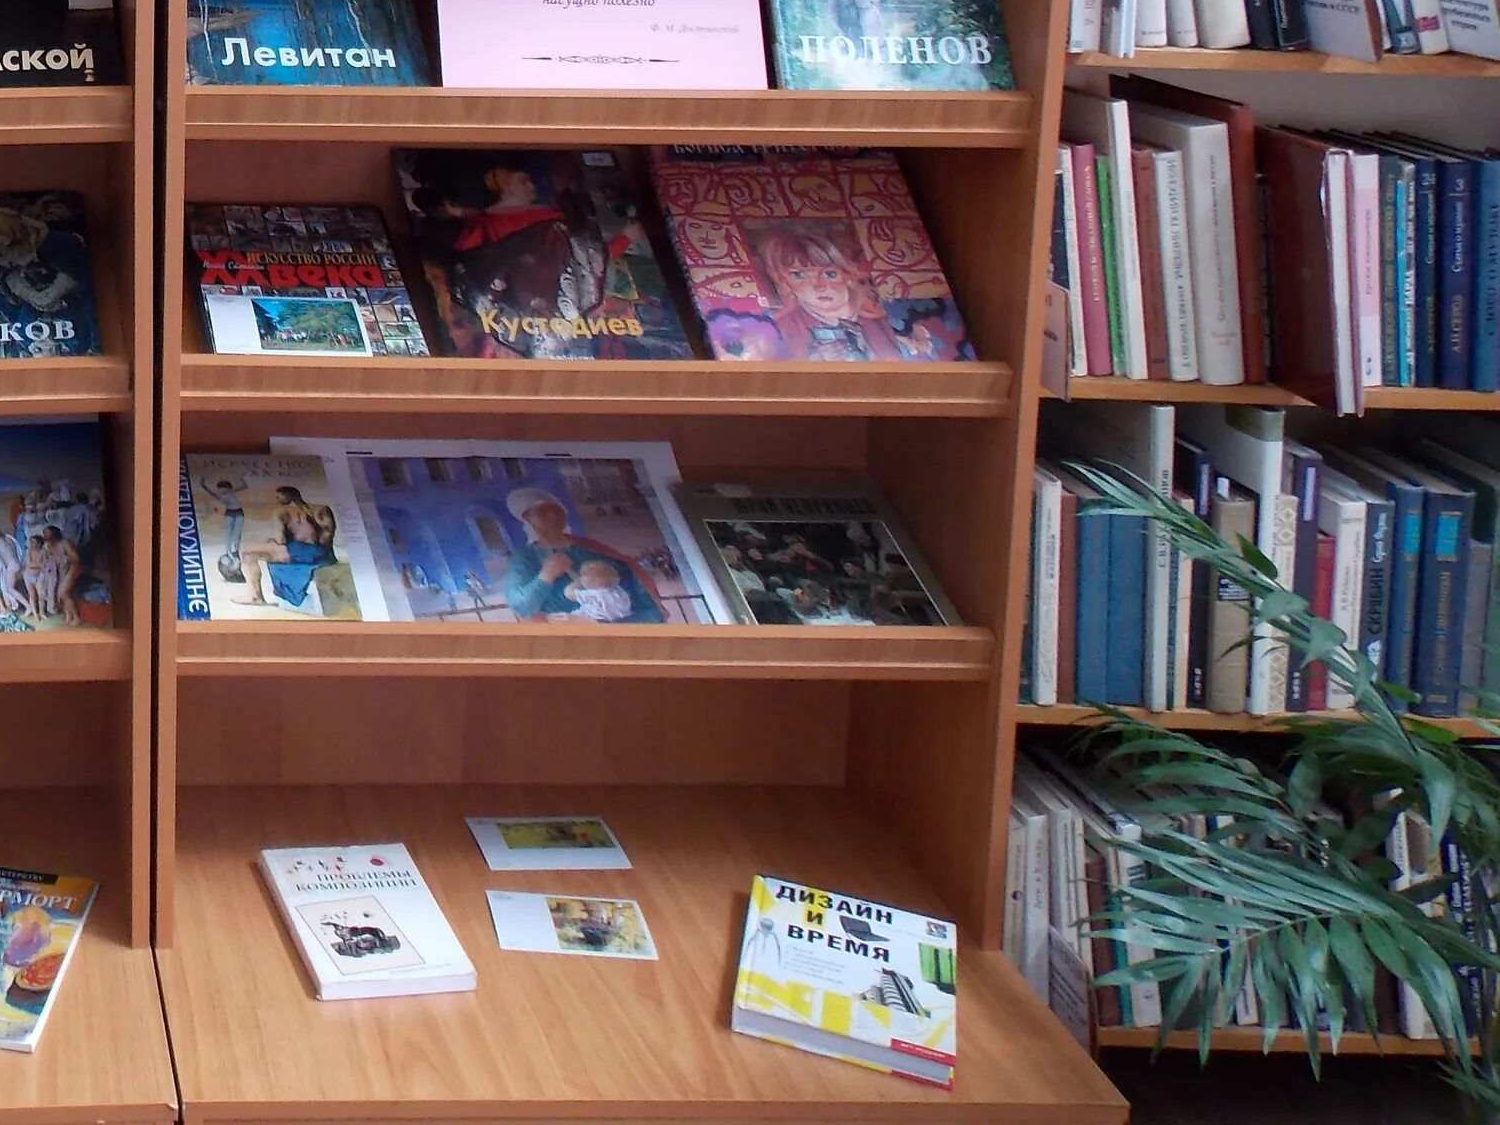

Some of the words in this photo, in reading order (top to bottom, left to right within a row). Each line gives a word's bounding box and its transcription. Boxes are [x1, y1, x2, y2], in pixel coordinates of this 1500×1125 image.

[222, 37, 397, 68] Левитан
[799, 35, 992, 65] ПОЛЕНОВ
[246, 251, 321, 266] ИСКУССТВО
[324, 252, 378, 266] РОССИИ
[477, 308, 645, 343] Кустодиев
[1367, 567, 1385, 635] СКРЯБИН
[775, 884, 893, 925] ДИЗАЙН
[807, 910, 825, 926] И
[787, 924, 891, 963] ВРЕМЯ
